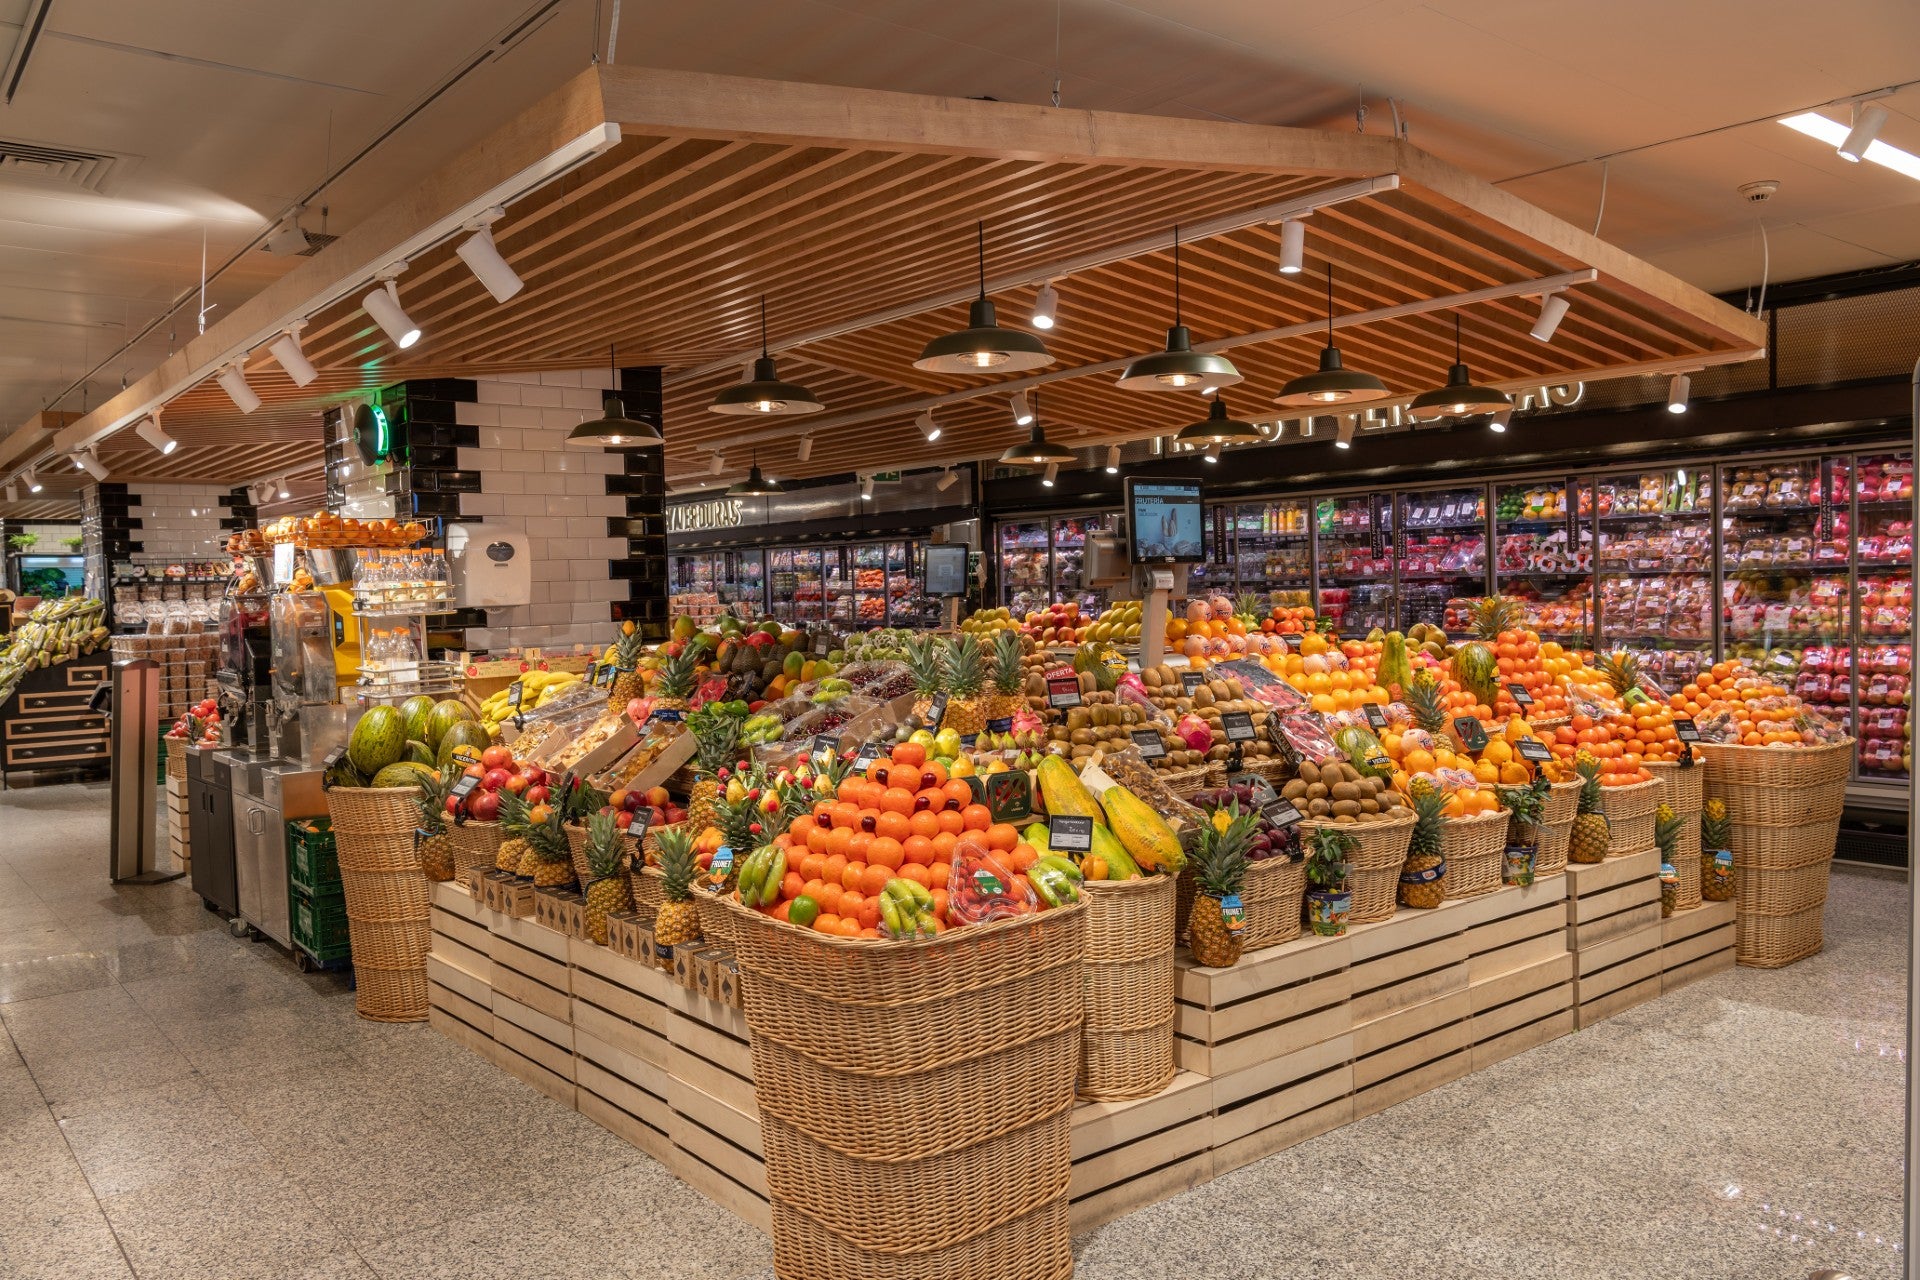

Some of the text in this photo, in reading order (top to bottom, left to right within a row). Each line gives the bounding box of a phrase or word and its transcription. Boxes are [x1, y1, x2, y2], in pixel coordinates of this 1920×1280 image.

[1135, 496, 1164, 505] FRUTERÍA
[678, 500, 743, 530] VERDURAS
[1046, 667, 1073, 680] OFERTA
[711, 860, 732, 868] FRUNET
[1222, 907, 1243, 916] FRUNET
